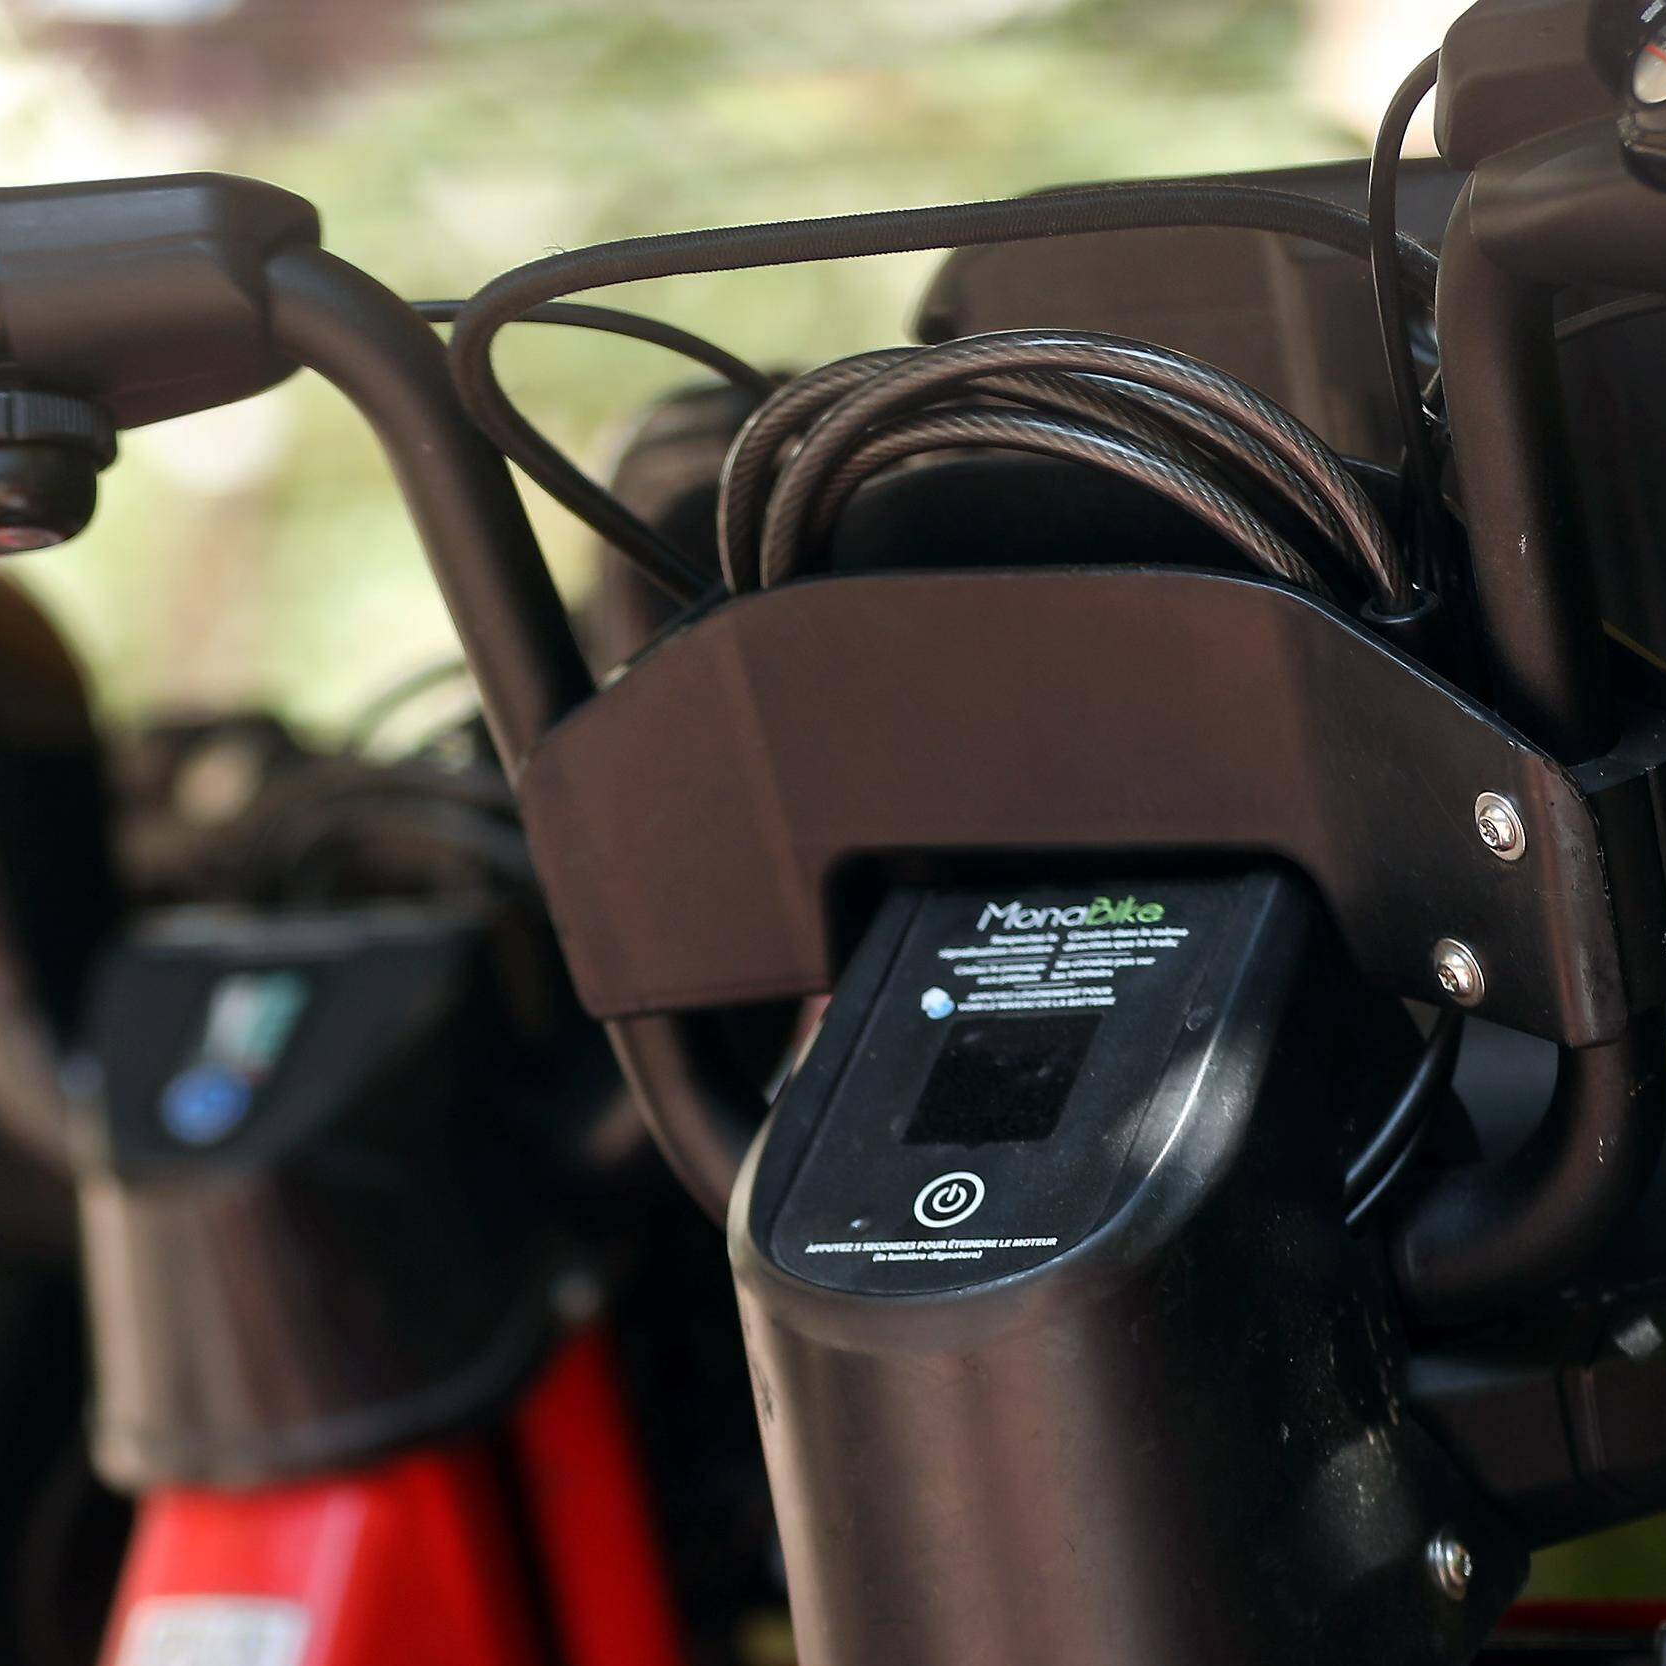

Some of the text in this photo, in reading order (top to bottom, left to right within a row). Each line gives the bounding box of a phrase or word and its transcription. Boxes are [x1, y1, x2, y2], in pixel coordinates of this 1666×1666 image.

[976, 895, 1165, 932] MonaBike
[917, 1240, 947, 1251] POUR
[999, 1239, 1012, 1248] LE
[1012, 1237, 1058, 1248] MOTEUR
